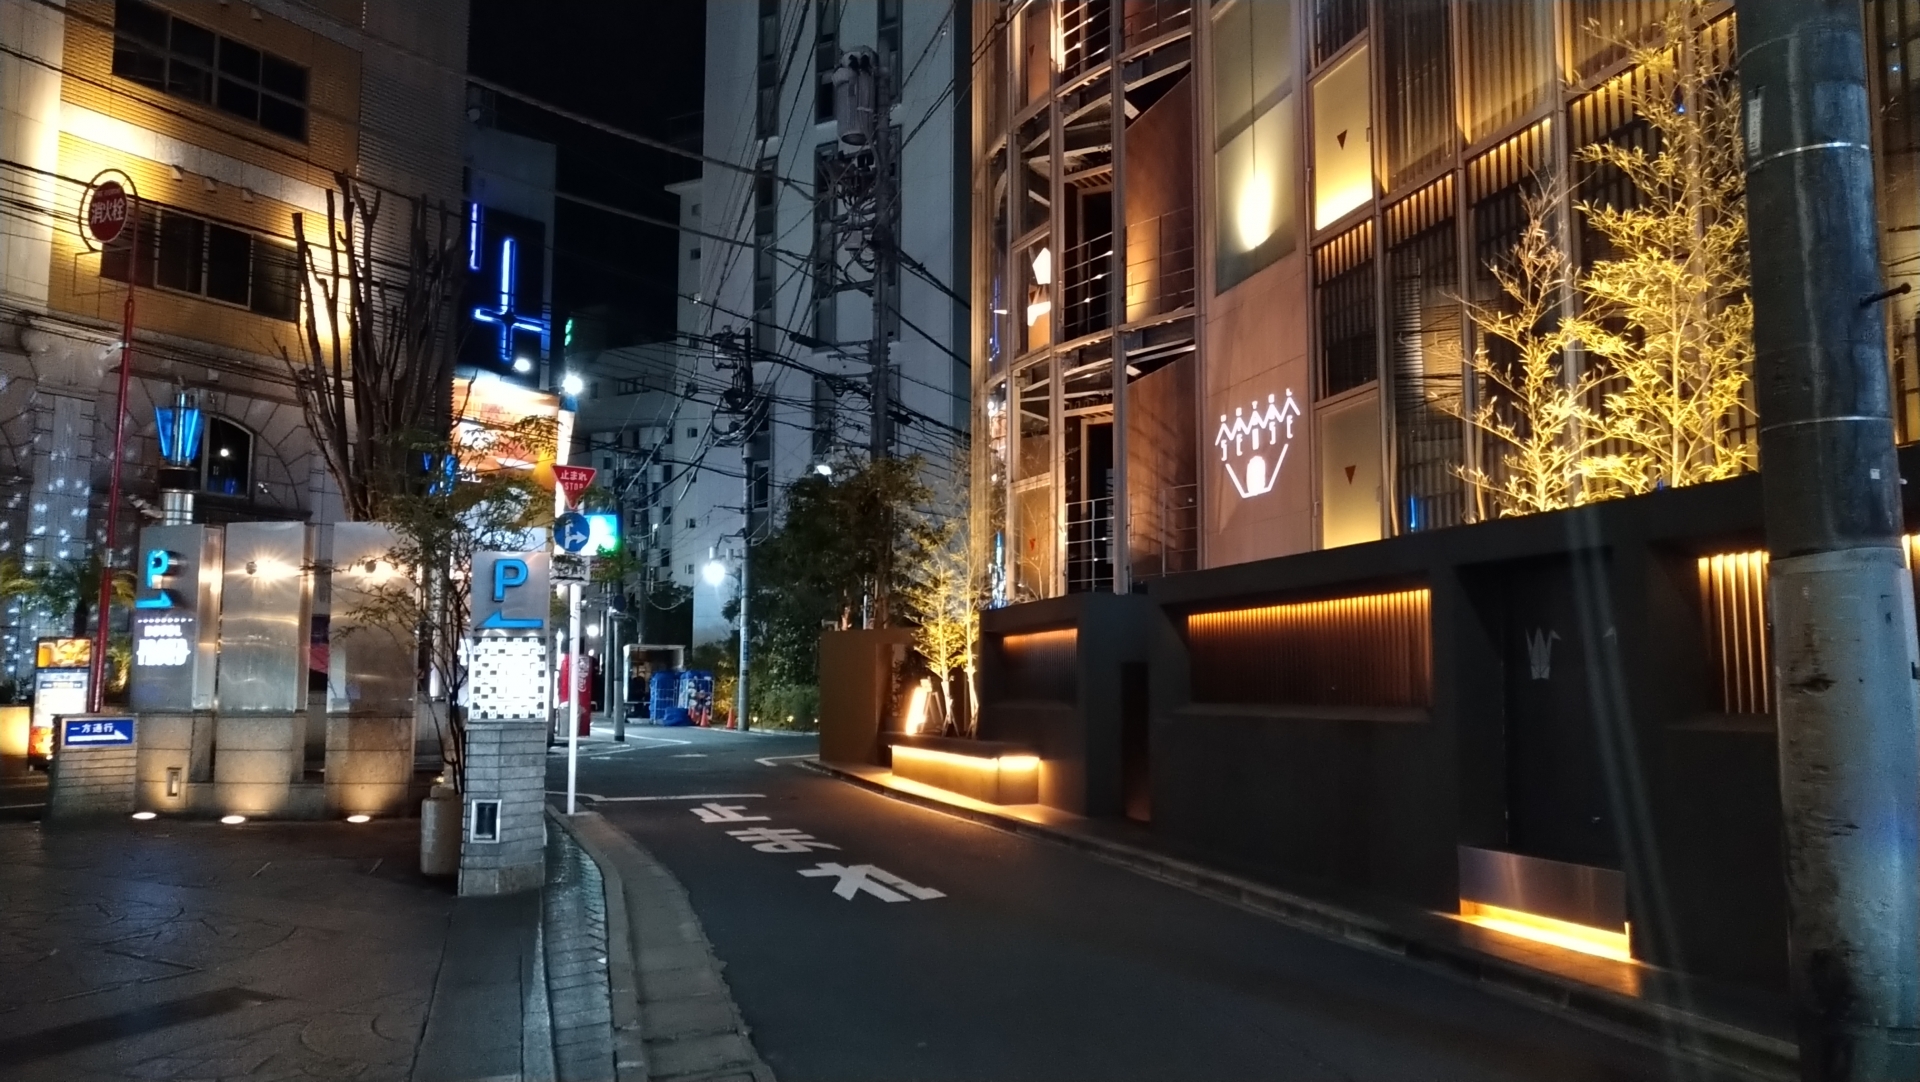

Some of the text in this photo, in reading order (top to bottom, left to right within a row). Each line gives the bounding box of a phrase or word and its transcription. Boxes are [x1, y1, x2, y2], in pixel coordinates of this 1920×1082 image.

[91, 197, 125, 224] 消火栓
[560, 469, 588, 481] 止まれ
[564, 482, 584, 491] STOP
[146, 549, 170, 590] P
[493, 558, 529, 602] P
[69, 722, 114, 734] 一方通行
[689, 802, 948, 903] 止まれ
